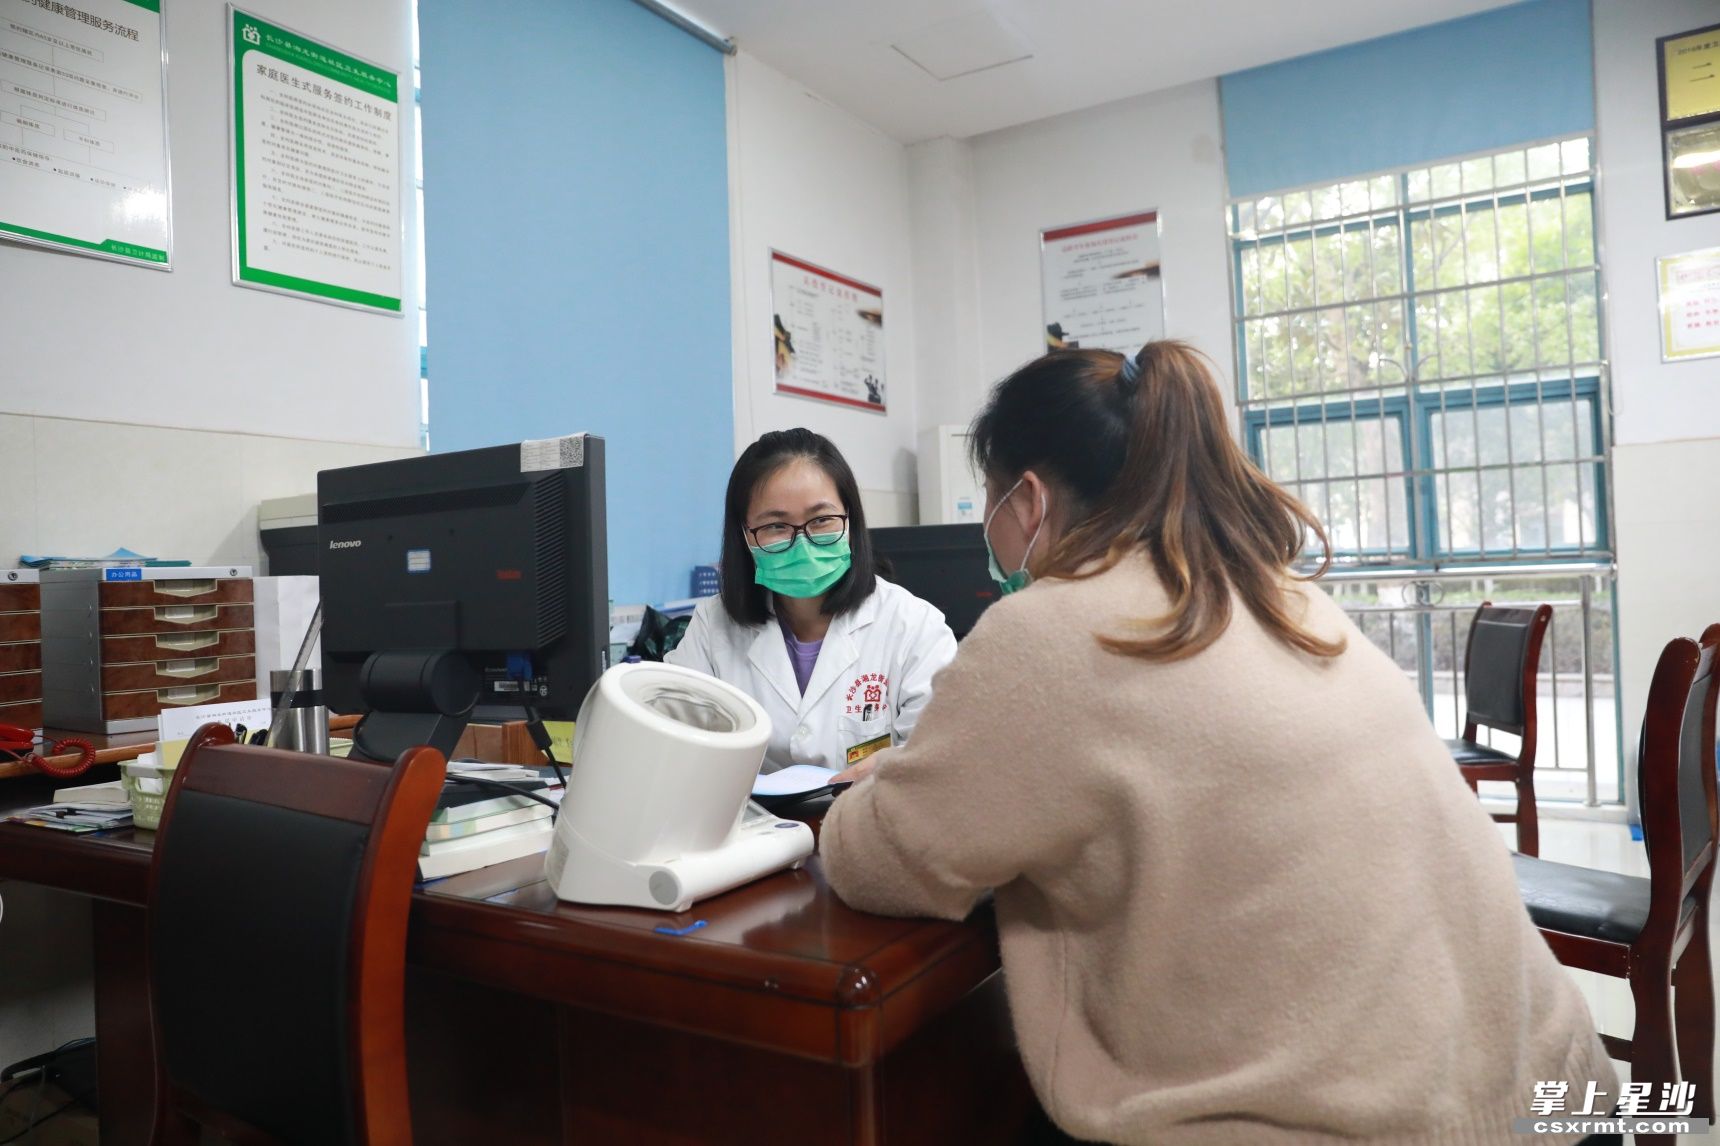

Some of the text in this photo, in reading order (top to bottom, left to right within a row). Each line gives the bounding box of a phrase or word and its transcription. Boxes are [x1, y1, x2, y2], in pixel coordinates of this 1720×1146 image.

[256, 63, 392, 121] 家庭医生式服务签约工作制度
[329, 540, 362, 550] lenovo
